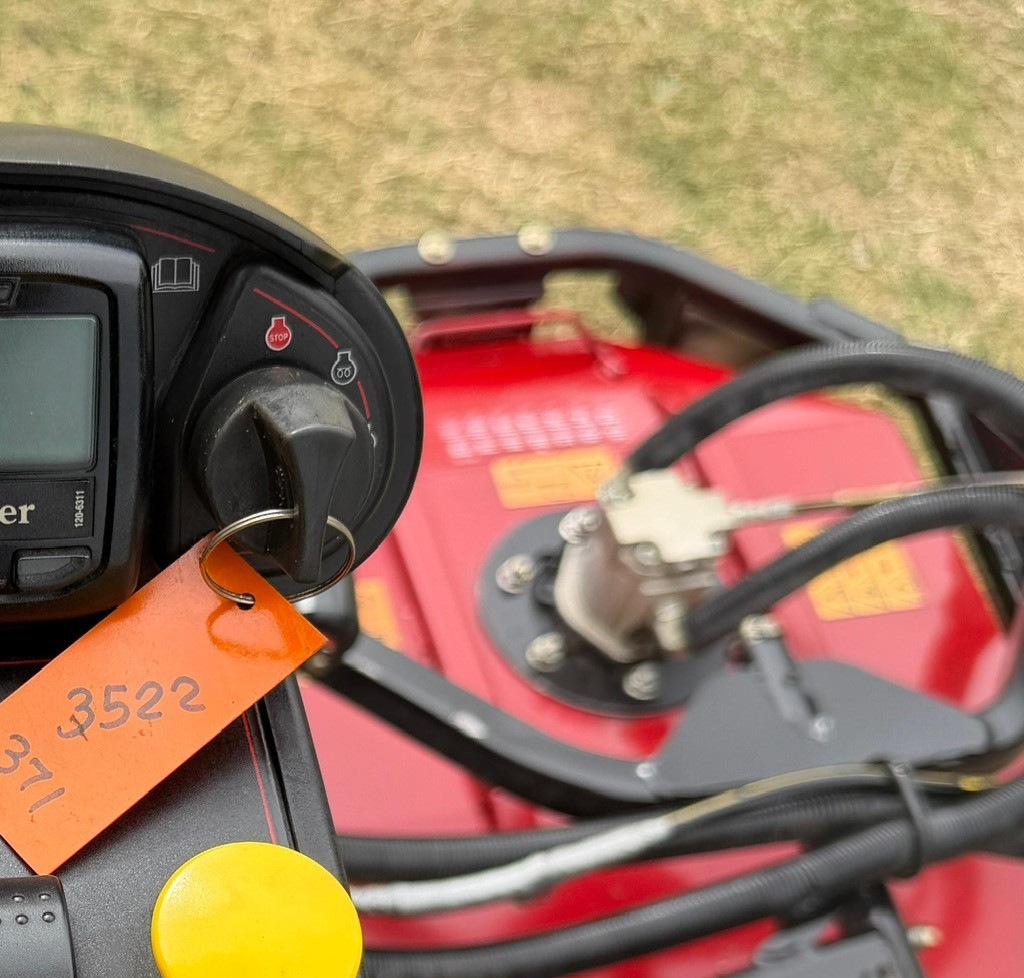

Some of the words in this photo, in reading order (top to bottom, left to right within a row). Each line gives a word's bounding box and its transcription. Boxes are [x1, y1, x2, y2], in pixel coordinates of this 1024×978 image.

[269, 332, 289, 343] STOP
[74, 490, 85, 528] 120-6311
[56, 675, 207, 740] 3522
